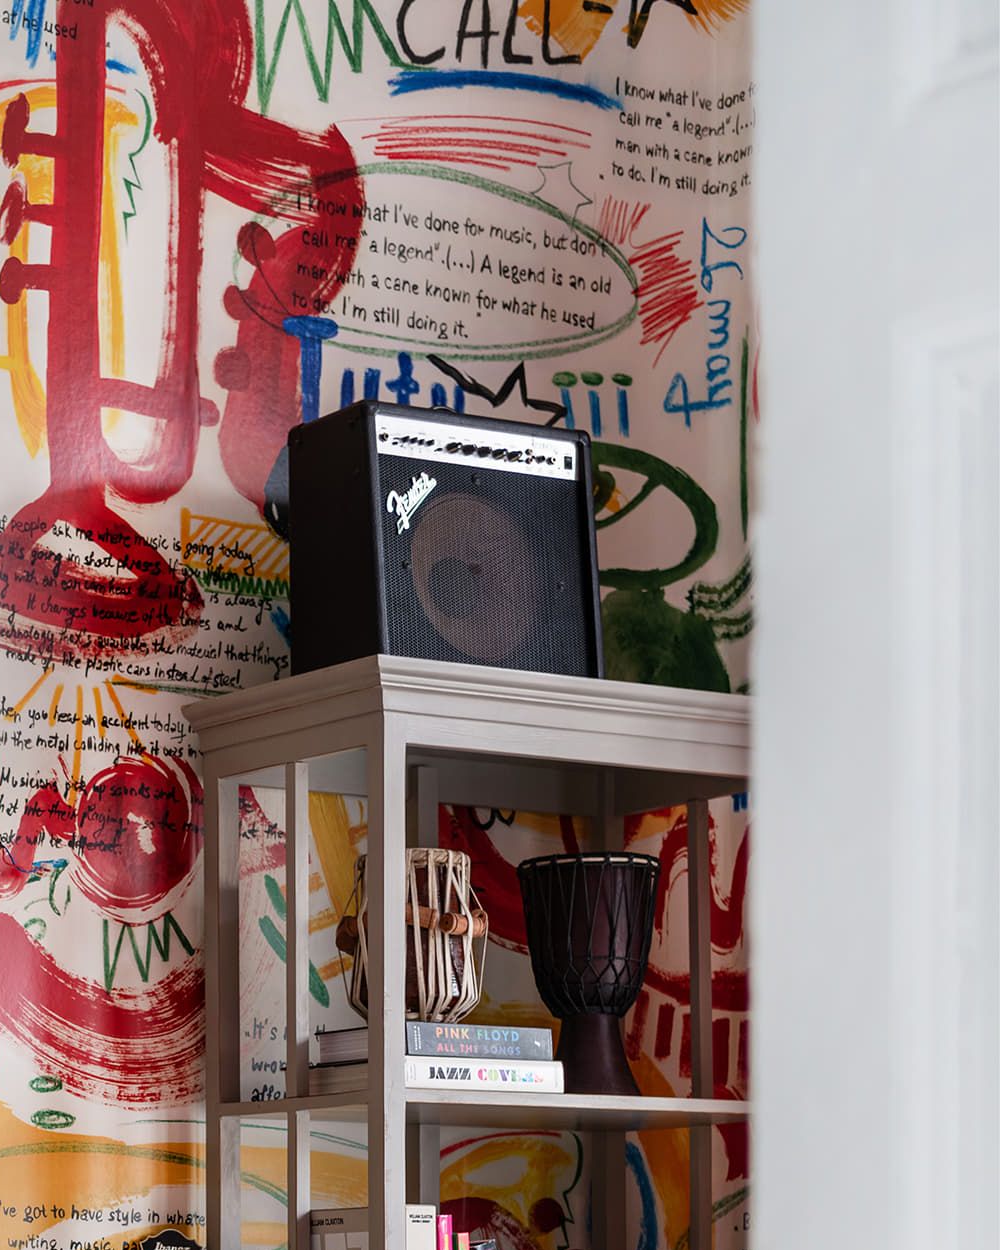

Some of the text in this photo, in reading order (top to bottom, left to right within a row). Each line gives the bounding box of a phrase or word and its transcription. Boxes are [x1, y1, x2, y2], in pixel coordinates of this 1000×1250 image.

[22, 12, 39, 32] he
[44, 20, 78, 40] used
[624, 80, 746, 111] know what I've done
[619, 111, 662, 129] call me
[615, 138, 641, 154] man
[645, 143, 670, 160] with
[684, 150, 713, 167] cane
[612, 161, 739, 197] to I'm still doing
[352, 200, 569, 250] what I've done for music, but
[301, 229, 613, 295] call A legend is an old
[700, 217, 747, 293] 26
[336, 268, 366, 288] with
[384, 276, 421, 296] cane
[424, 279, 471, 303] known
[476, 289, 498, 311] for
[502, 297, 538, 318] what
[541, 302, 558, 323] he
[562, 311, 596, 330] used
[342, 295, 470, 340] I'm still doing it.
[28, 707, 48, 729] you
[74, 736, 120, 765] colliding
[435, 1026, 470, 1041] PINK
[475, 1028, 521, 1043] FLOYD
[435, 1042, 521, 1057] ALL THE SONGS
[429, 1065, 471, 1081] JAZZ
[23, 1203, 48, 1223] got
[51, 1203, 66, 1219] to
[71, 1204, 105, 1224] have
[107, 1204, 143, 1228] style
[147, 1208, 161, 1224] in
